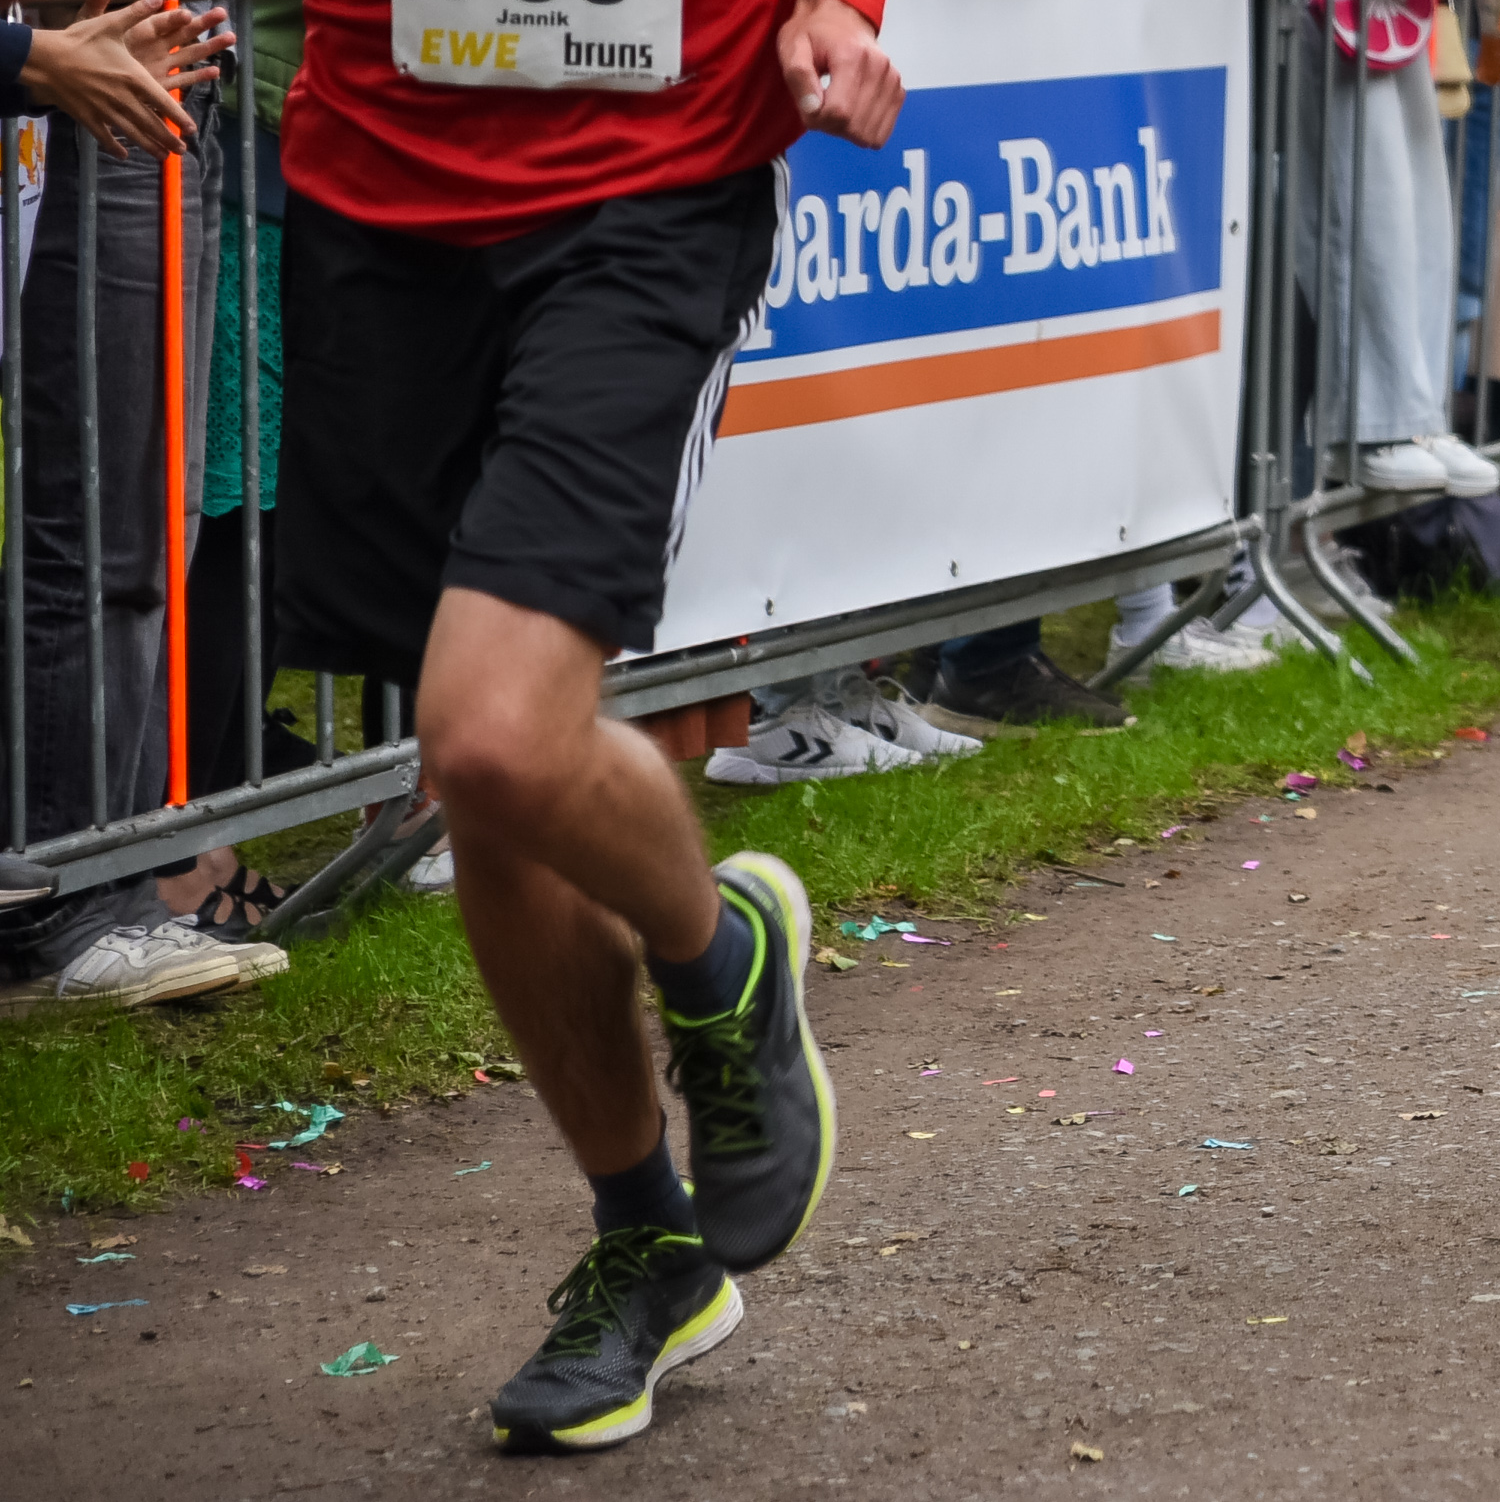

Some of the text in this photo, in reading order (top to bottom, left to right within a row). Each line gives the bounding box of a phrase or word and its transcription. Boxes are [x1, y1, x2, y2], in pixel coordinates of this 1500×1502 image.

[496, 9, 570, 27] Jannik
[420, 28, 520, 69] EWE
[564, 32, 653, 69] bruns
[741, 126, 1177, 351] parda-Bank
